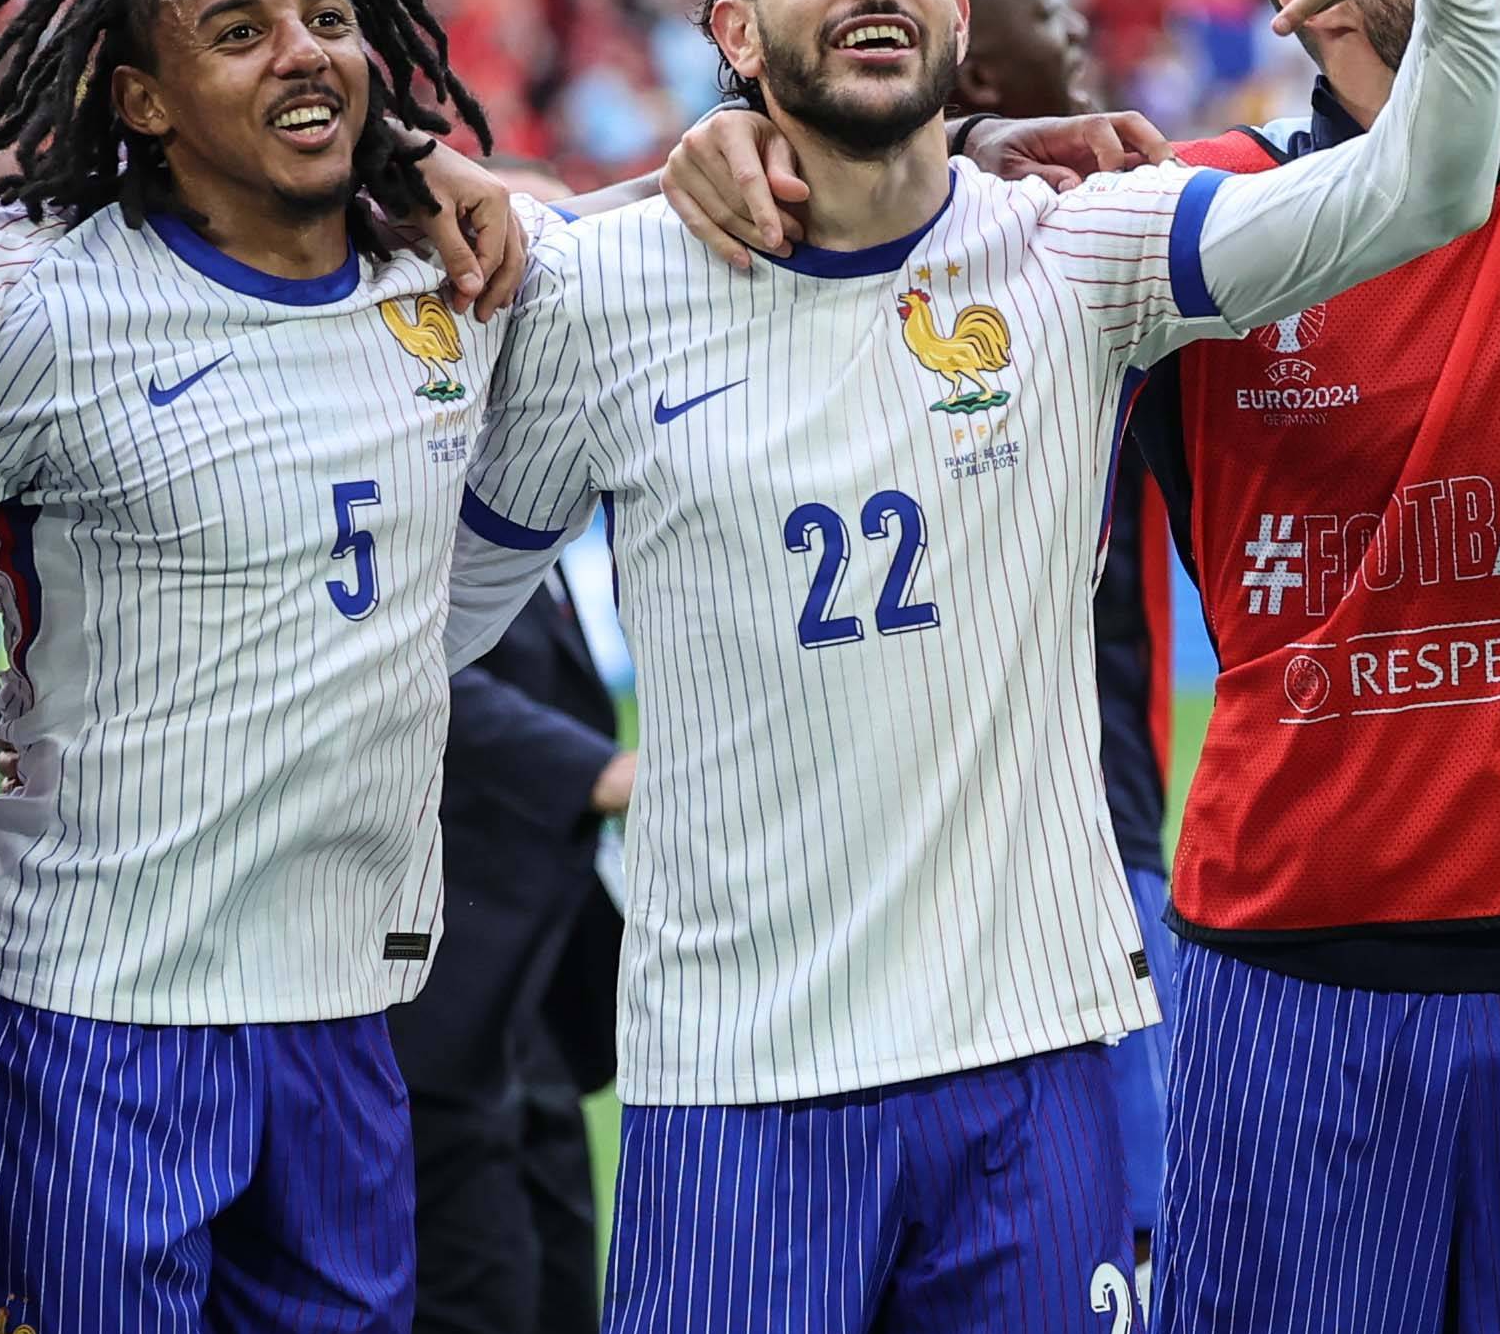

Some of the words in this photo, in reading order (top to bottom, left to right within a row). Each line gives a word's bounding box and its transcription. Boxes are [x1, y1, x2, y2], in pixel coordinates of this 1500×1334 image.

[1237, 385, 1360, 410] EURO2024
[1267, 364, 1311, 382] UEFA
[325, 479, 381, 623] 5
[783, 489, 941, 650] 22
